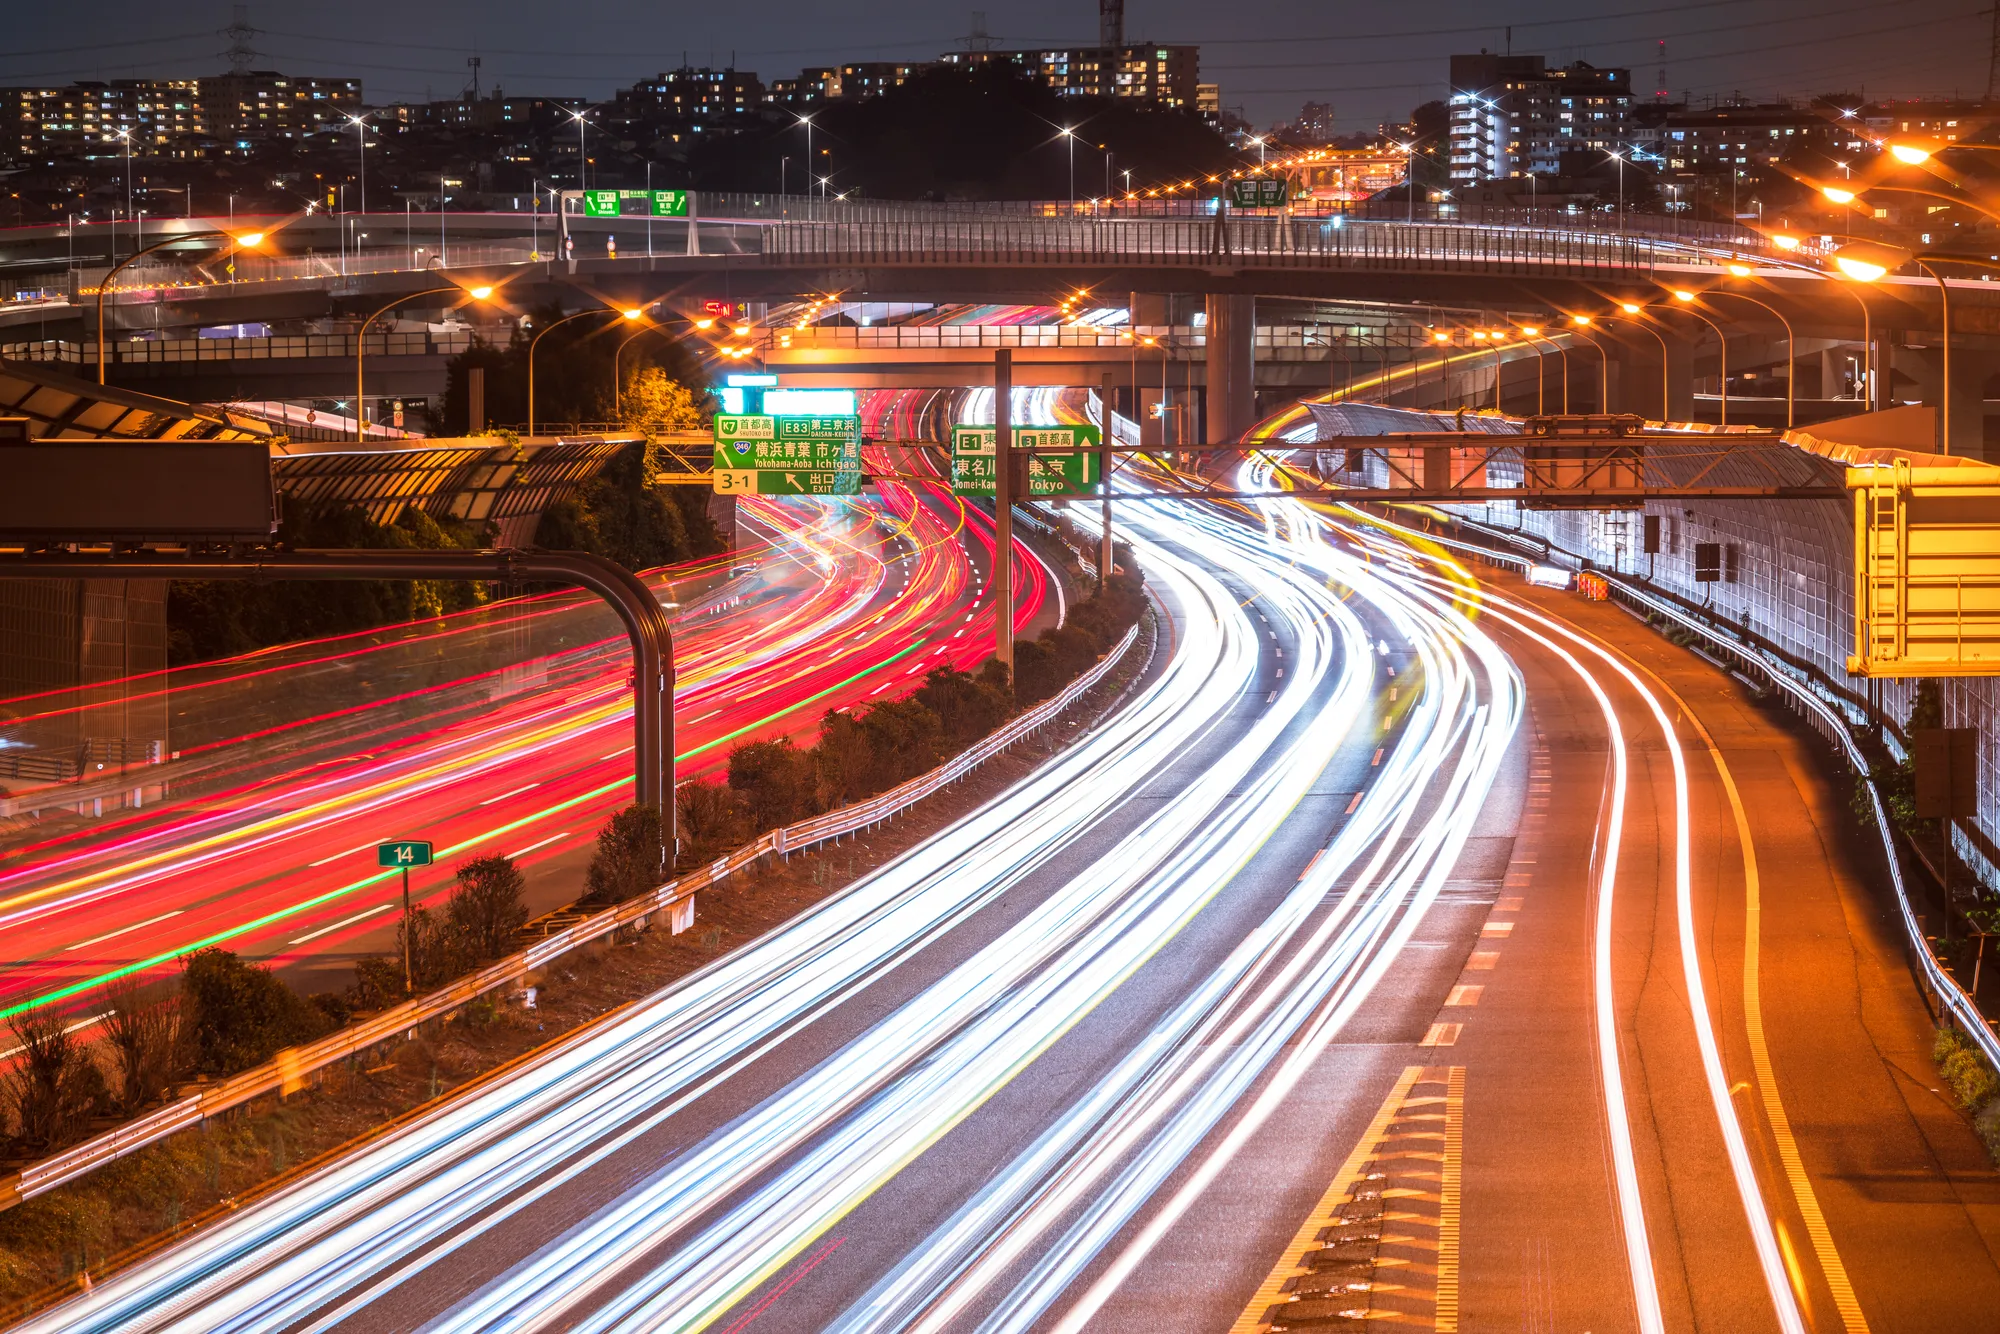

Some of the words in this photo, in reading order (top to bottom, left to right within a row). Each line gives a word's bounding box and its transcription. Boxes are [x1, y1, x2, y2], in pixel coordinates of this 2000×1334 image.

[723, 422, 735, 432] K7
[740, 418, 772, 430] 首都高
[785, 422, 808, 433] E83
[811, 419, 854, 431] 第三京浜
[962, 436, 978, 448] E1
[984, 432, 996, 444] 東
[1038, 432, 1071, 446] 首都高
[735, 443, 749, 451] 246
[756, 442, 810, 458] 横浜青葉
[754, 458, 812, 468] Yokohama-Aoba
[816, 459, 856, 470] Ichigao
[956, 458, 996, 476] 東名川
[1029, 459, 1066, 476] 東京
[722, 474, 749, 489] 3-1
[810, 473, 834, 484] 出口
[955, 479, 996, 490] Tomei-Kaw
[1030, 480, 1064, 492] Tokyo
[394, 846, 414, 863] 14
